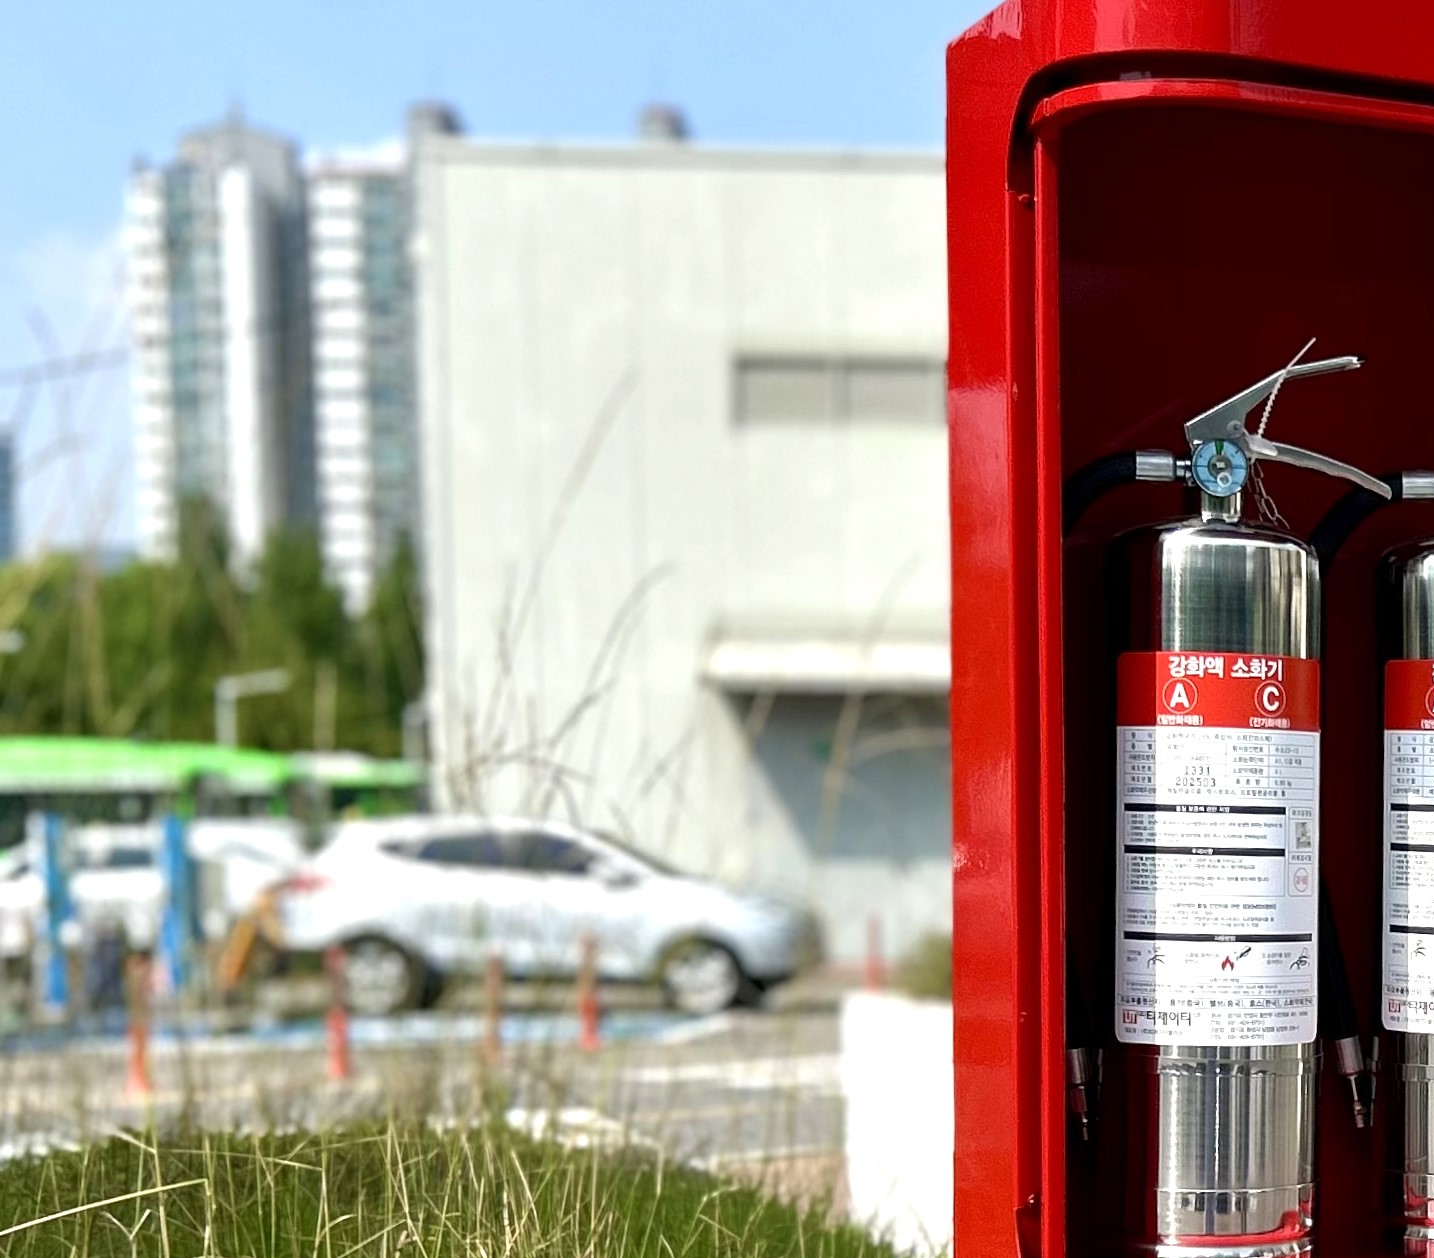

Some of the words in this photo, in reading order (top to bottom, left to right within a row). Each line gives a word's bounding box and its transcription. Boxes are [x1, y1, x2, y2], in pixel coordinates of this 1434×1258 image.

[1168, 655, 1224, 678] 강화액
[1230, 658, 1283, 682] 소화기
[1169, 682, 1190, 709] A
[1262, 686, 1280, 712] C
[1175, 776, 1216, 787] 202503
[1184, 765, 1210, 776] 1331
